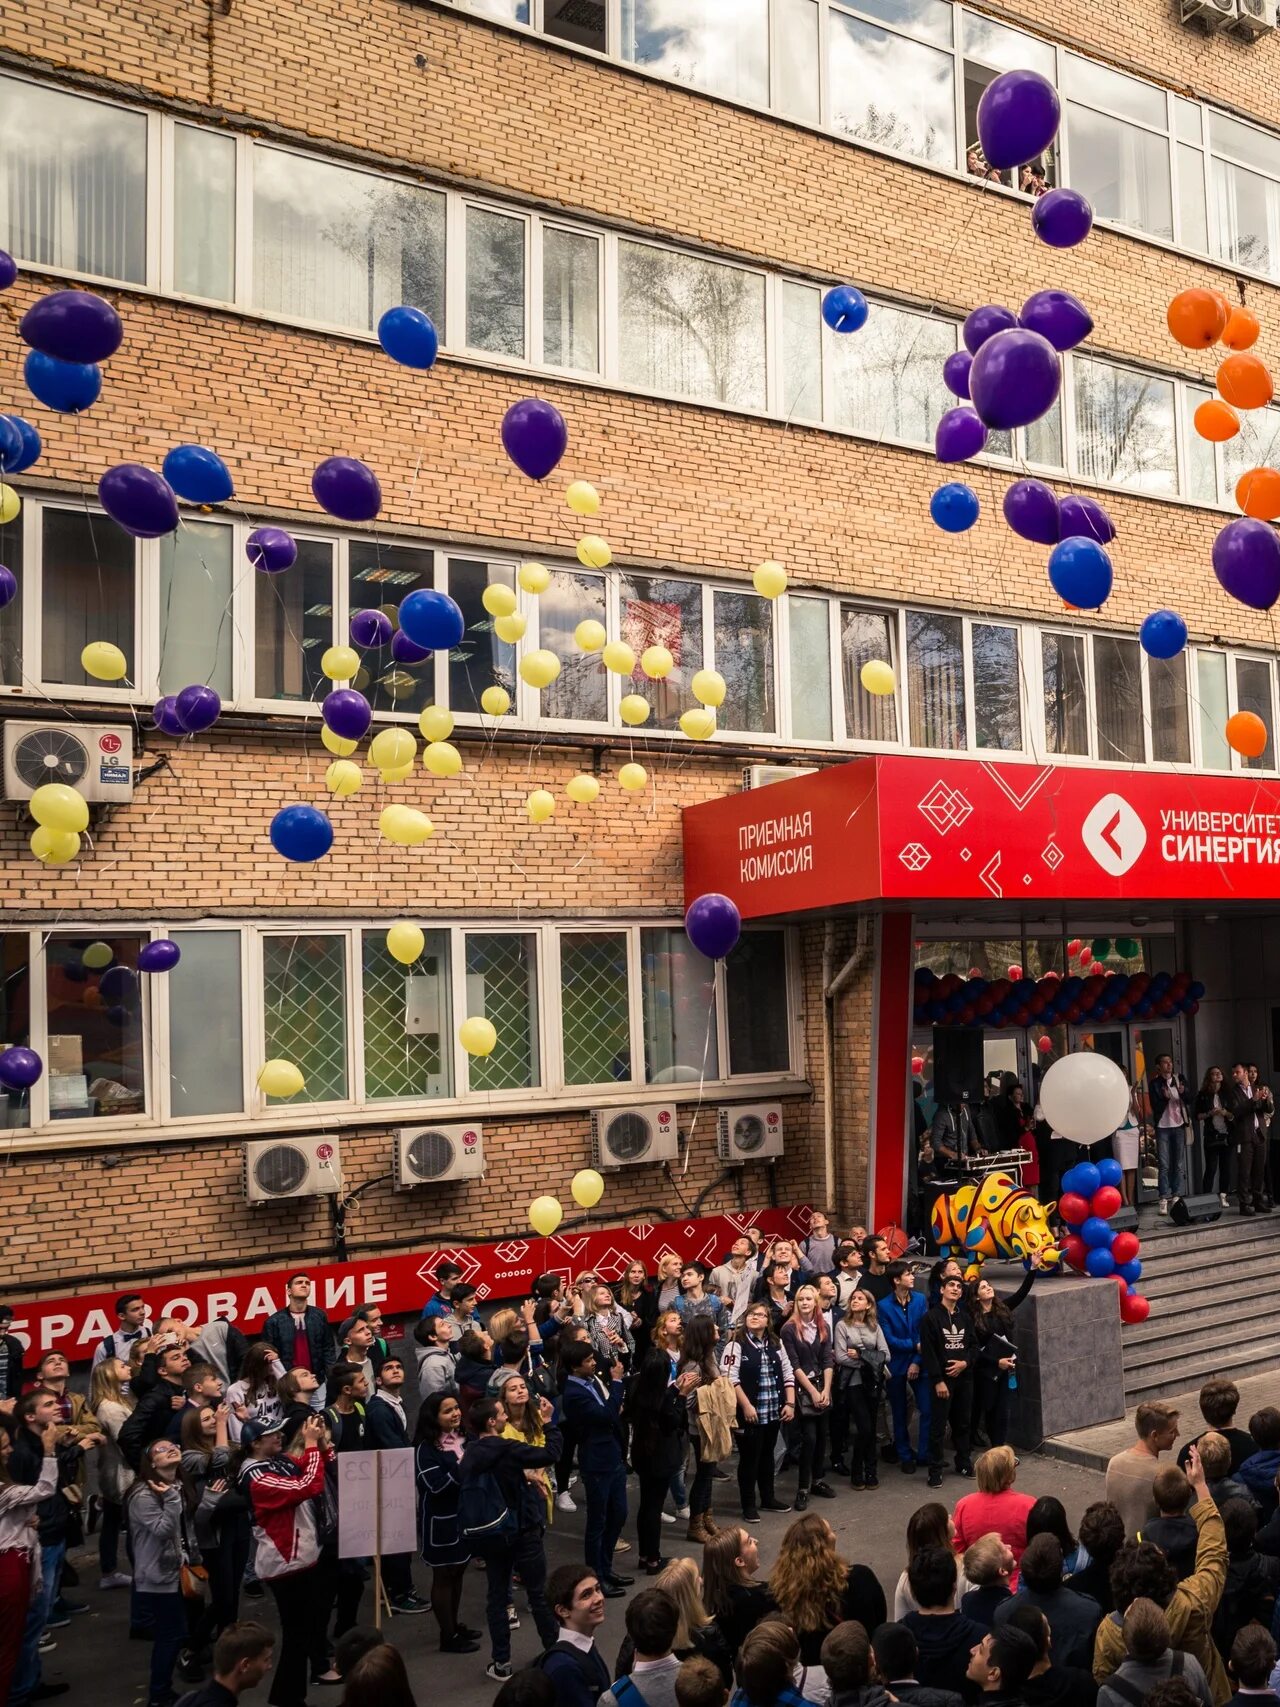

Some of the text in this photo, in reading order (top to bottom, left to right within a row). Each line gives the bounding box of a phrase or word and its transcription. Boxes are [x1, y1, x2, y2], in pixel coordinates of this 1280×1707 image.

[101, 755, 119, 765] LG
[739, 810, 812, 851] ПРИЕМНАЯ
[740, 845, 813, 883] КОМИССИЯ
[659, 1125, 670, 1133] LG
[464, 1146, 477, 1155] LG
